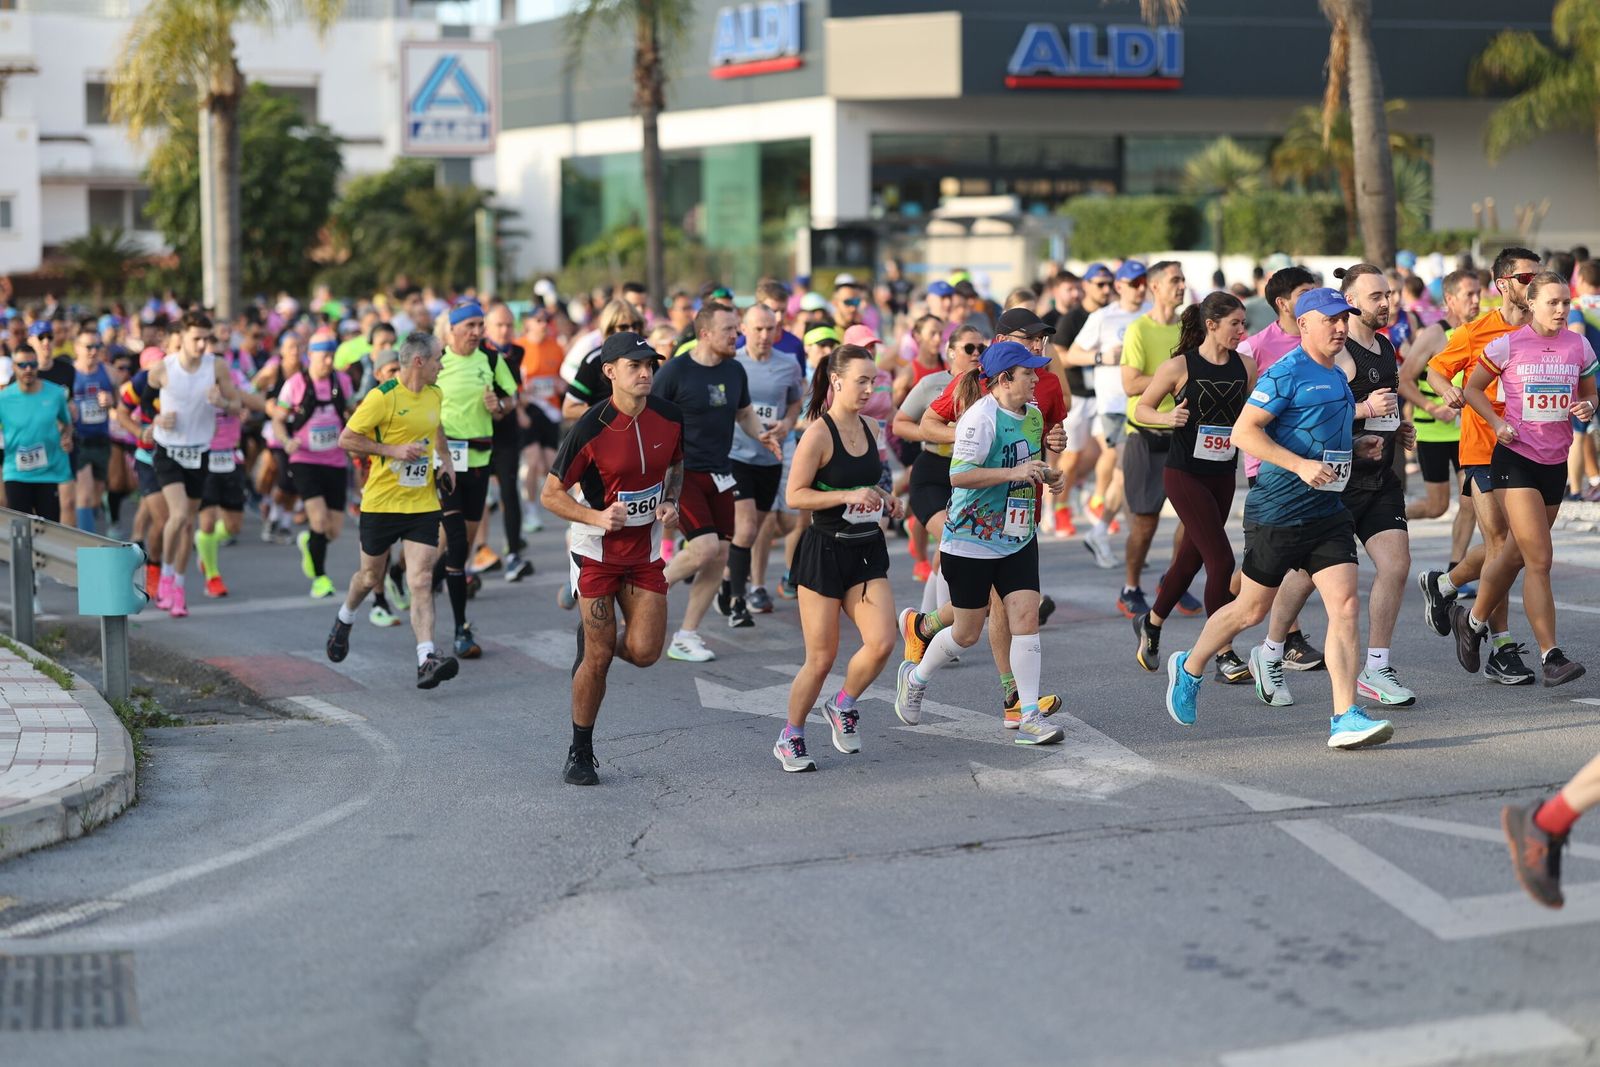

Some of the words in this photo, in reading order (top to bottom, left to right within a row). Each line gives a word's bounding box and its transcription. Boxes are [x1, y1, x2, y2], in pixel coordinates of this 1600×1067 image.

[709, 0, 803, 66] ALDI
[1008, 24, 1184, 76] ALDI
[1540, 354, 1563, 363] XXXVI
[1516, 364, 1544, 376] MEDIA
[1526, 394, 1569, 410] 1310
[1203, 435, 1231, 451] 594
[404, 464, 428, 478] 149
[626, 496, 658, 517] 360
